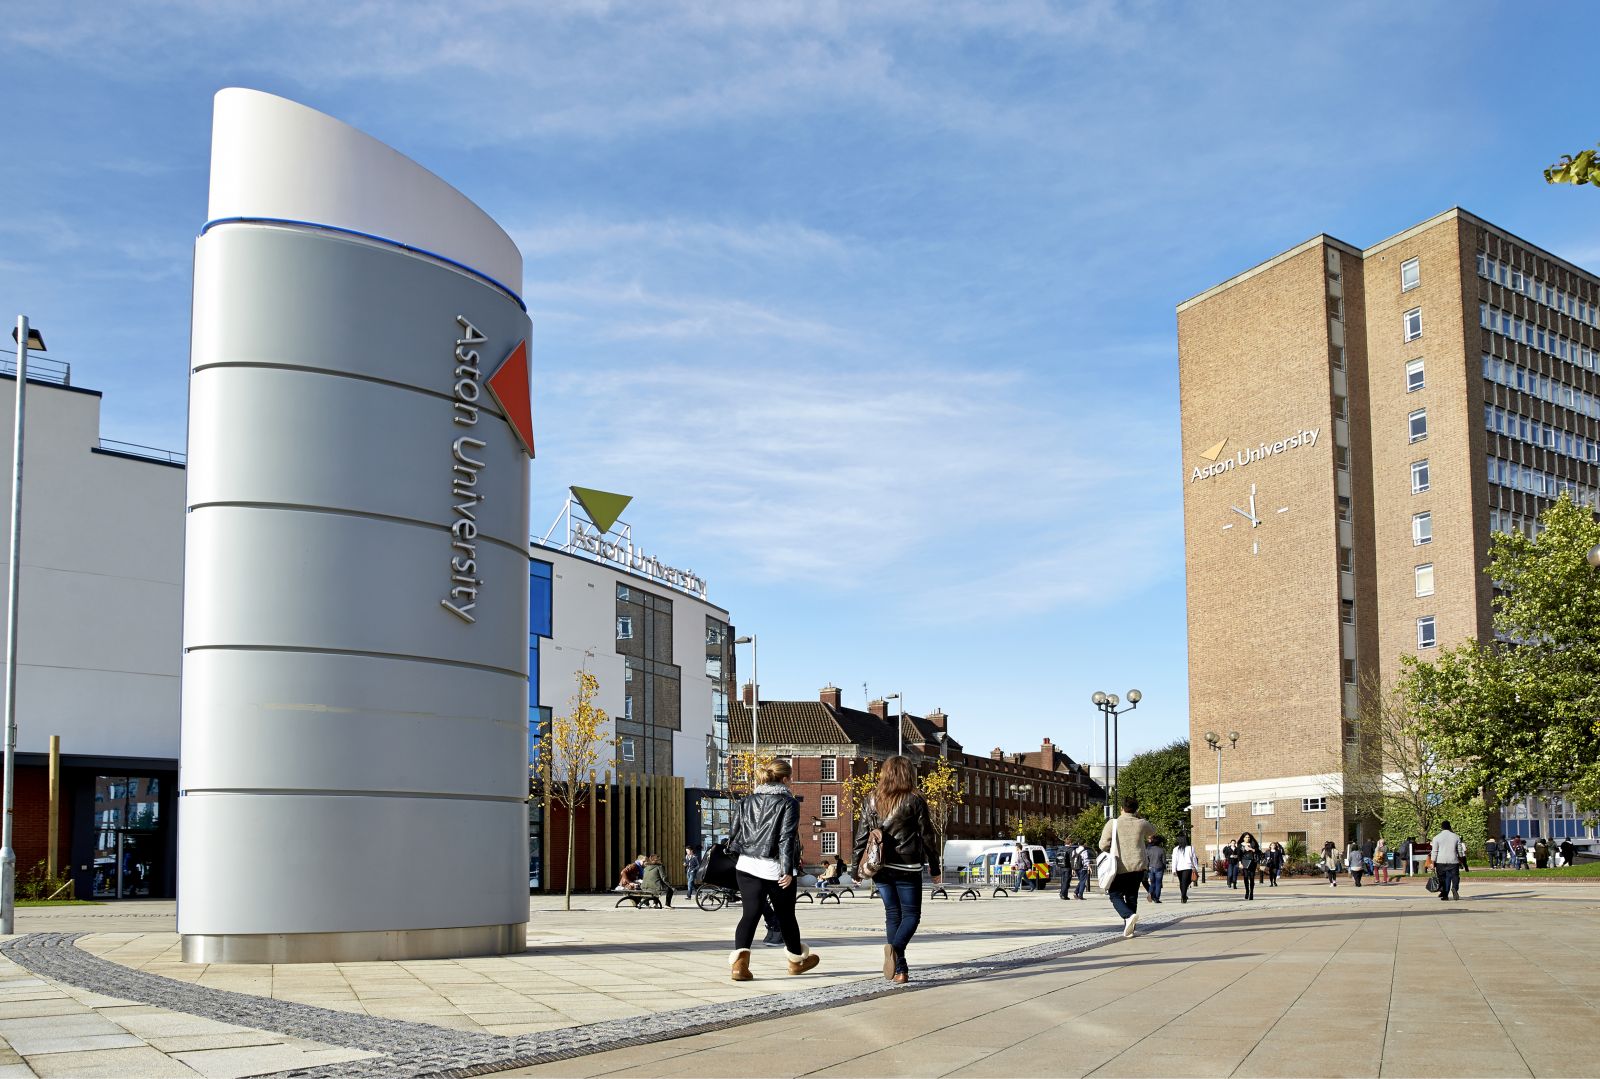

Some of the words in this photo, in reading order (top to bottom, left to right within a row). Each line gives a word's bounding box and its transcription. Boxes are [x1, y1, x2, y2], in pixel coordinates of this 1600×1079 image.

[455, 314, 488, 426] Aston
[1191, 458, 1234, 483] Aston
[1237, 428, 1320, 466] University
[441, 436, 486, 624] University
[573, 522, 626, 566] Aston
[629, 543, 707, 596] University
